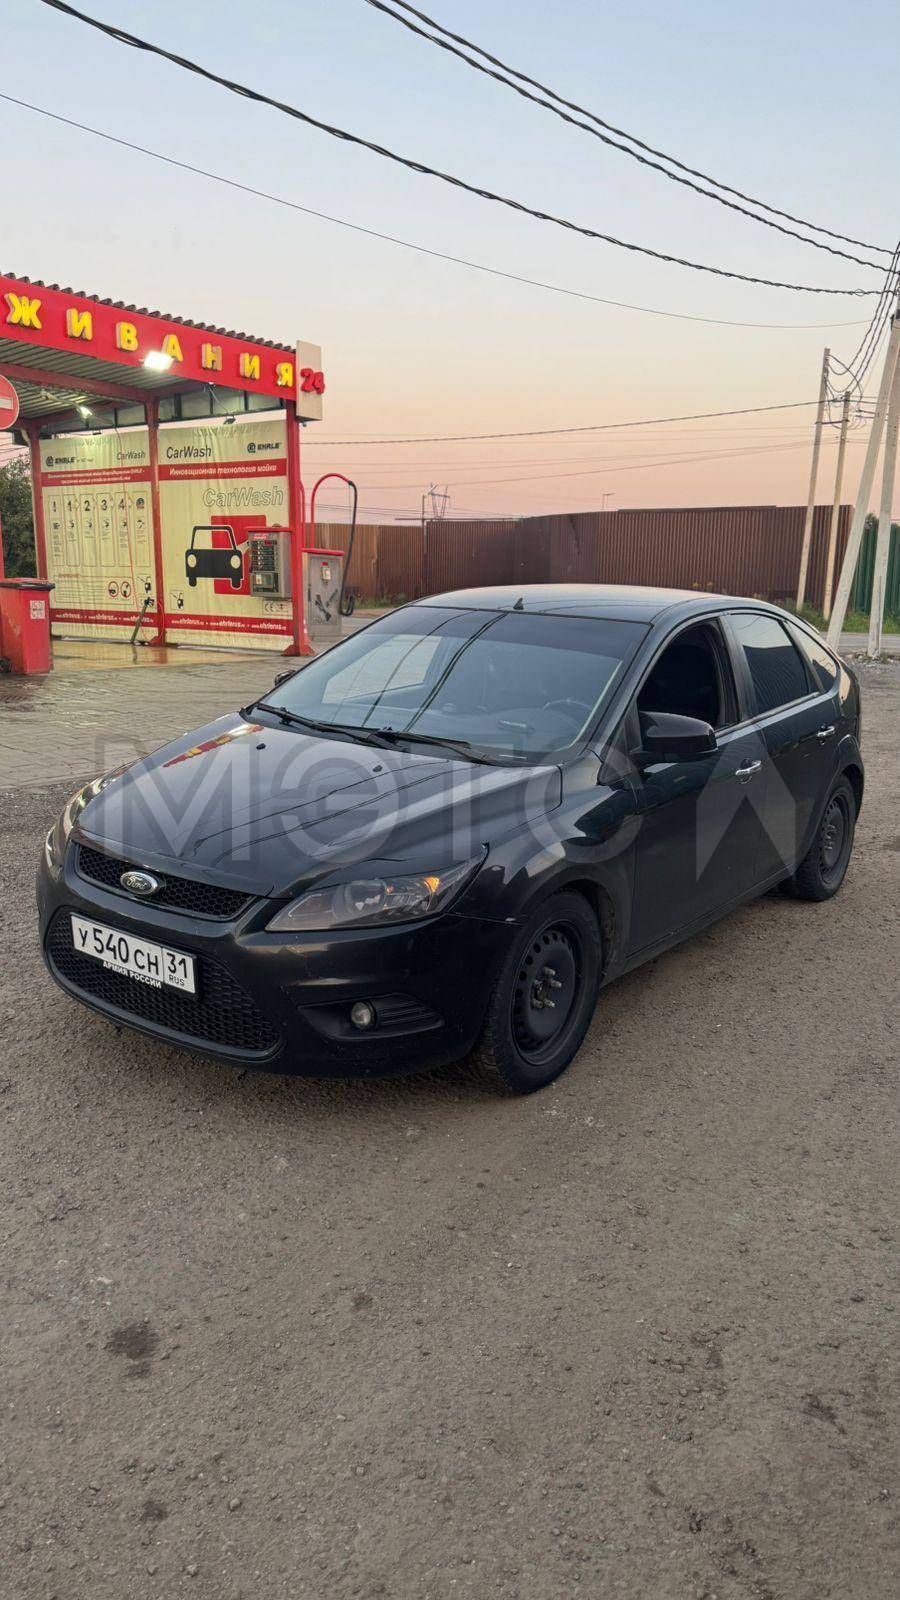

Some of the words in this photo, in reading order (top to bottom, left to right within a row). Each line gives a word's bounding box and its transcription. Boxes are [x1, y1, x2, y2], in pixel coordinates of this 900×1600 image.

[300, 368, 325, 395] 24
[166, 444, 212, 459] CarWash
[257, 443, 280, 451] EHRLE
[54, 456, 75, 464] EHRLE
[116, 450, 146, 461] CarWash
[203, 485, 284, 508] CarWash
[67, 500, 73, 512] 1
[84, 500, 91, 512] 2
[101, 499, 108, 511] 3
[118, 498, 125, 510] 4
[126, 875, 147, 891] Ford
[129, 970, 162, 989] РОССИИ
[168, 974, 186, 987] RUS
